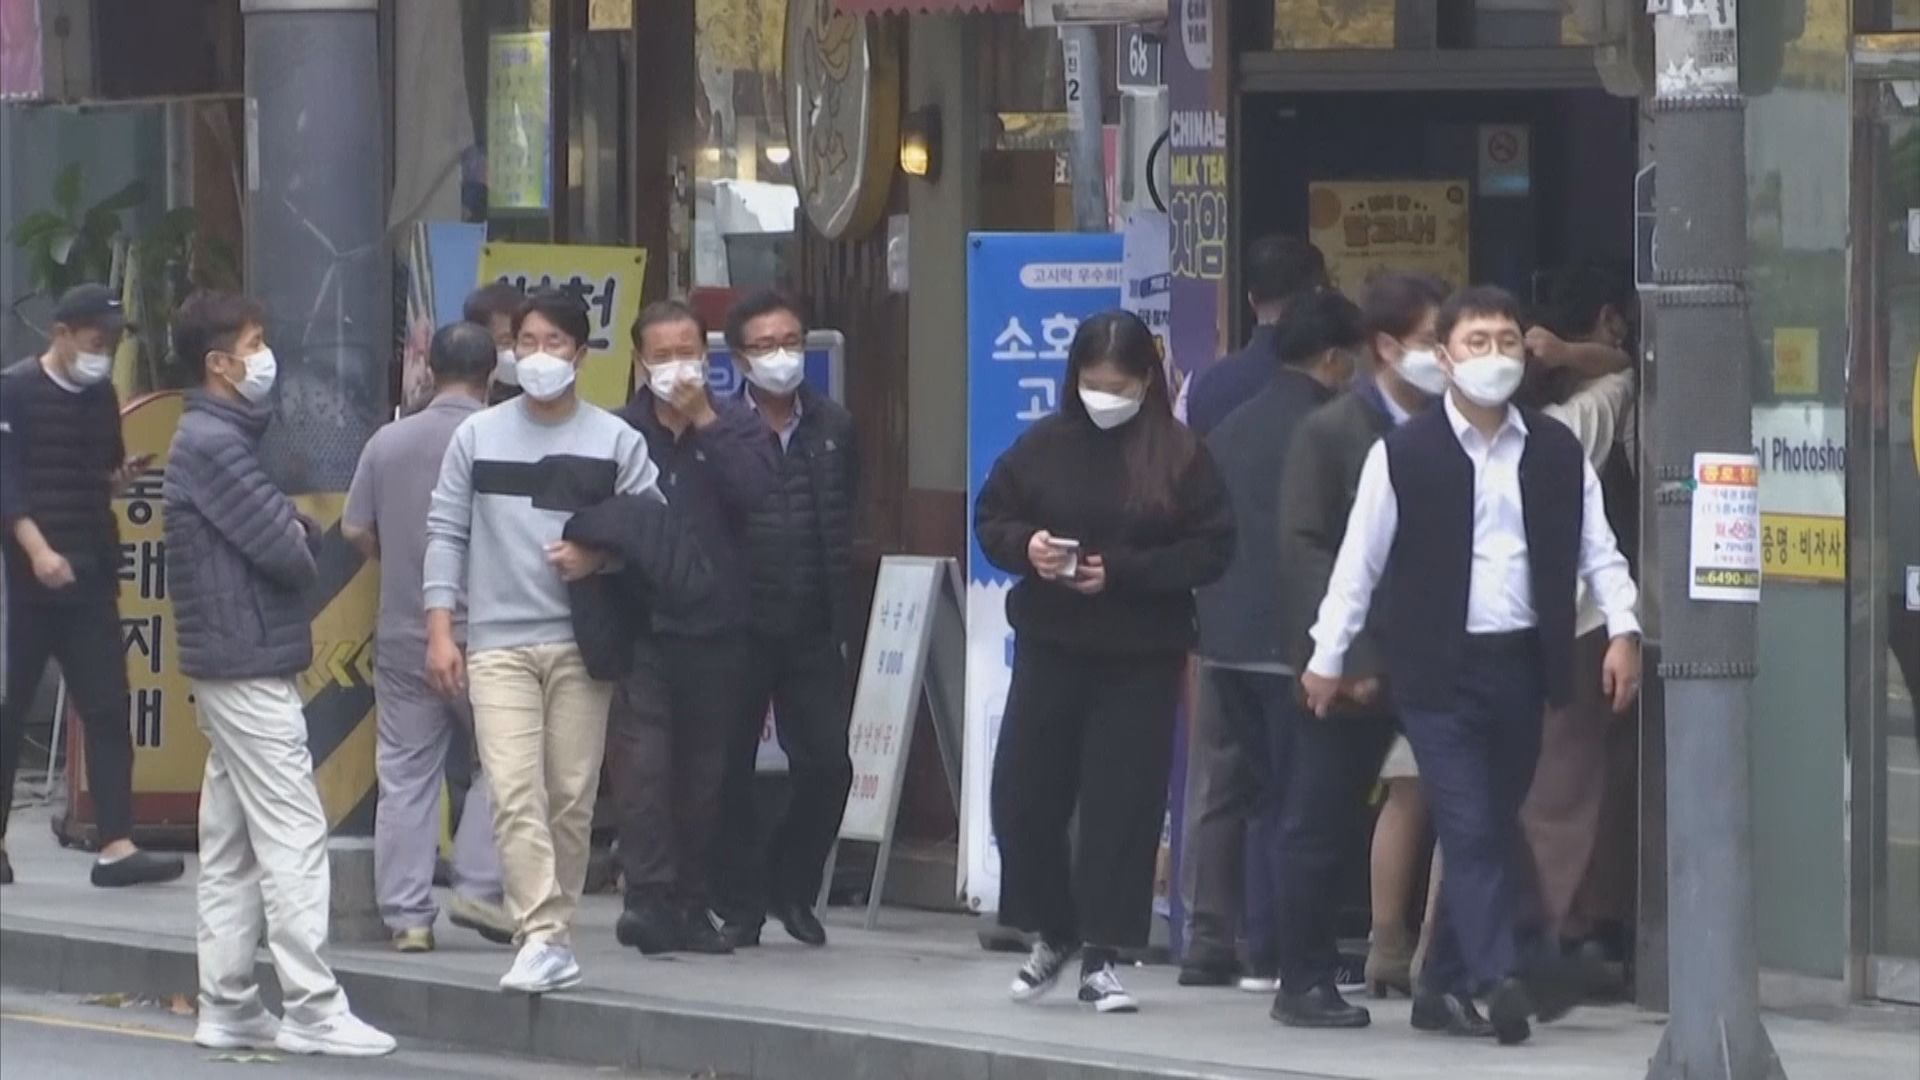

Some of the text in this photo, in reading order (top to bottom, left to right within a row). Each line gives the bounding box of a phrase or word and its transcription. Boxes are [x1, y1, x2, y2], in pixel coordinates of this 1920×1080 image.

[1129, 34, 1148, 77] 68
[1068, 78, 1080, 101] 2
[1170, 110, 1226, 147] CHINA는
[1171, 155, 1226, 186] MILK TEA
[991, 312, 1094, 360] 소호
[1762, 526, 1845, 566] 증명·비자사
